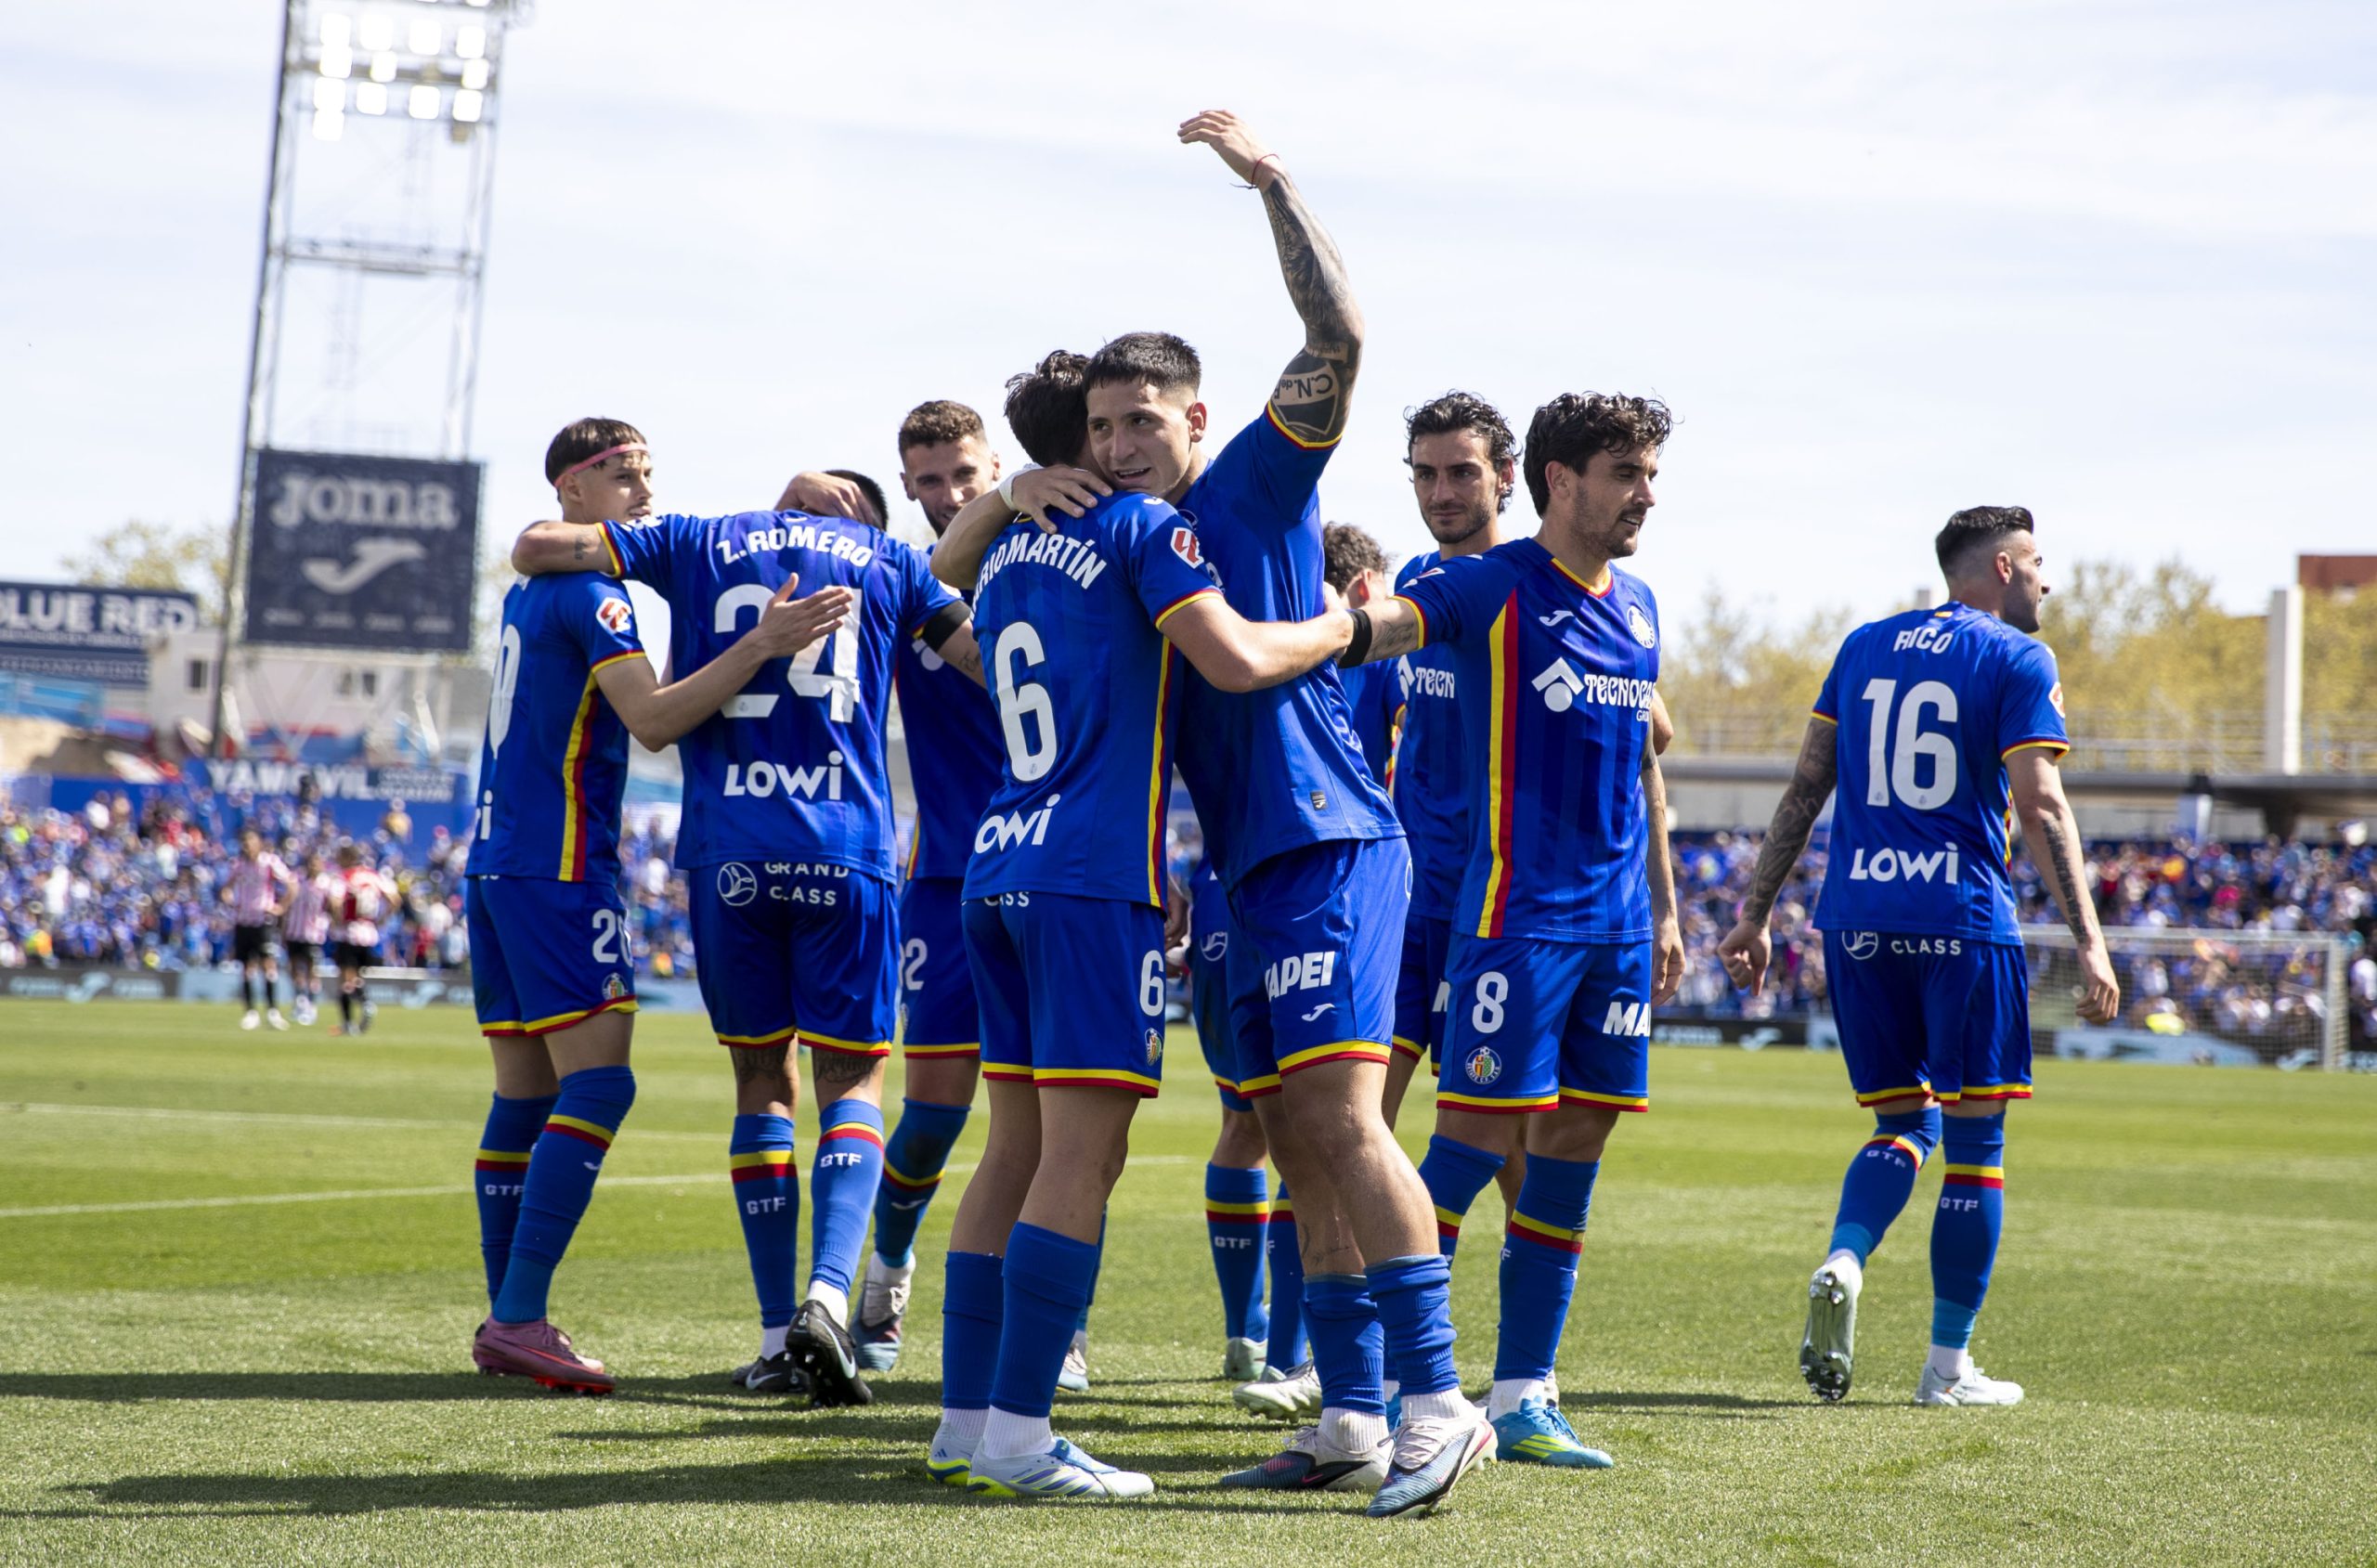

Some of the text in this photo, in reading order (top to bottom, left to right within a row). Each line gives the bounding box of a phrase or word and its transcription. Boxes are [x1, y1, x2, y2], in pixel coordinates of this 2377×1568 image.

[0, 588, 94, 633] LUE
[1893, 627, 1954, 654] RICO
[994, 621, 1058, 782] 6
[1861, 678, 1958, 810] 16
[769, 886, 837, 906] CASS
[1890, 940, 1962, 956] CLASS
[898, 938, 928, 991] 2
[1265, 951, 1336, 1004] APEI
[1139, 950, 1164, 1017] 6
[1472, 971, 1509, 1033] 8
[820, 1152, 863, 1168] GTF
[1865, 1148, 1907, 1168] GTF
[746, 1196, 787, 1215] GTF
[1941, 1197, 1979, 1212] GTF
[1214, 1236, 1252, 1250] GTF
